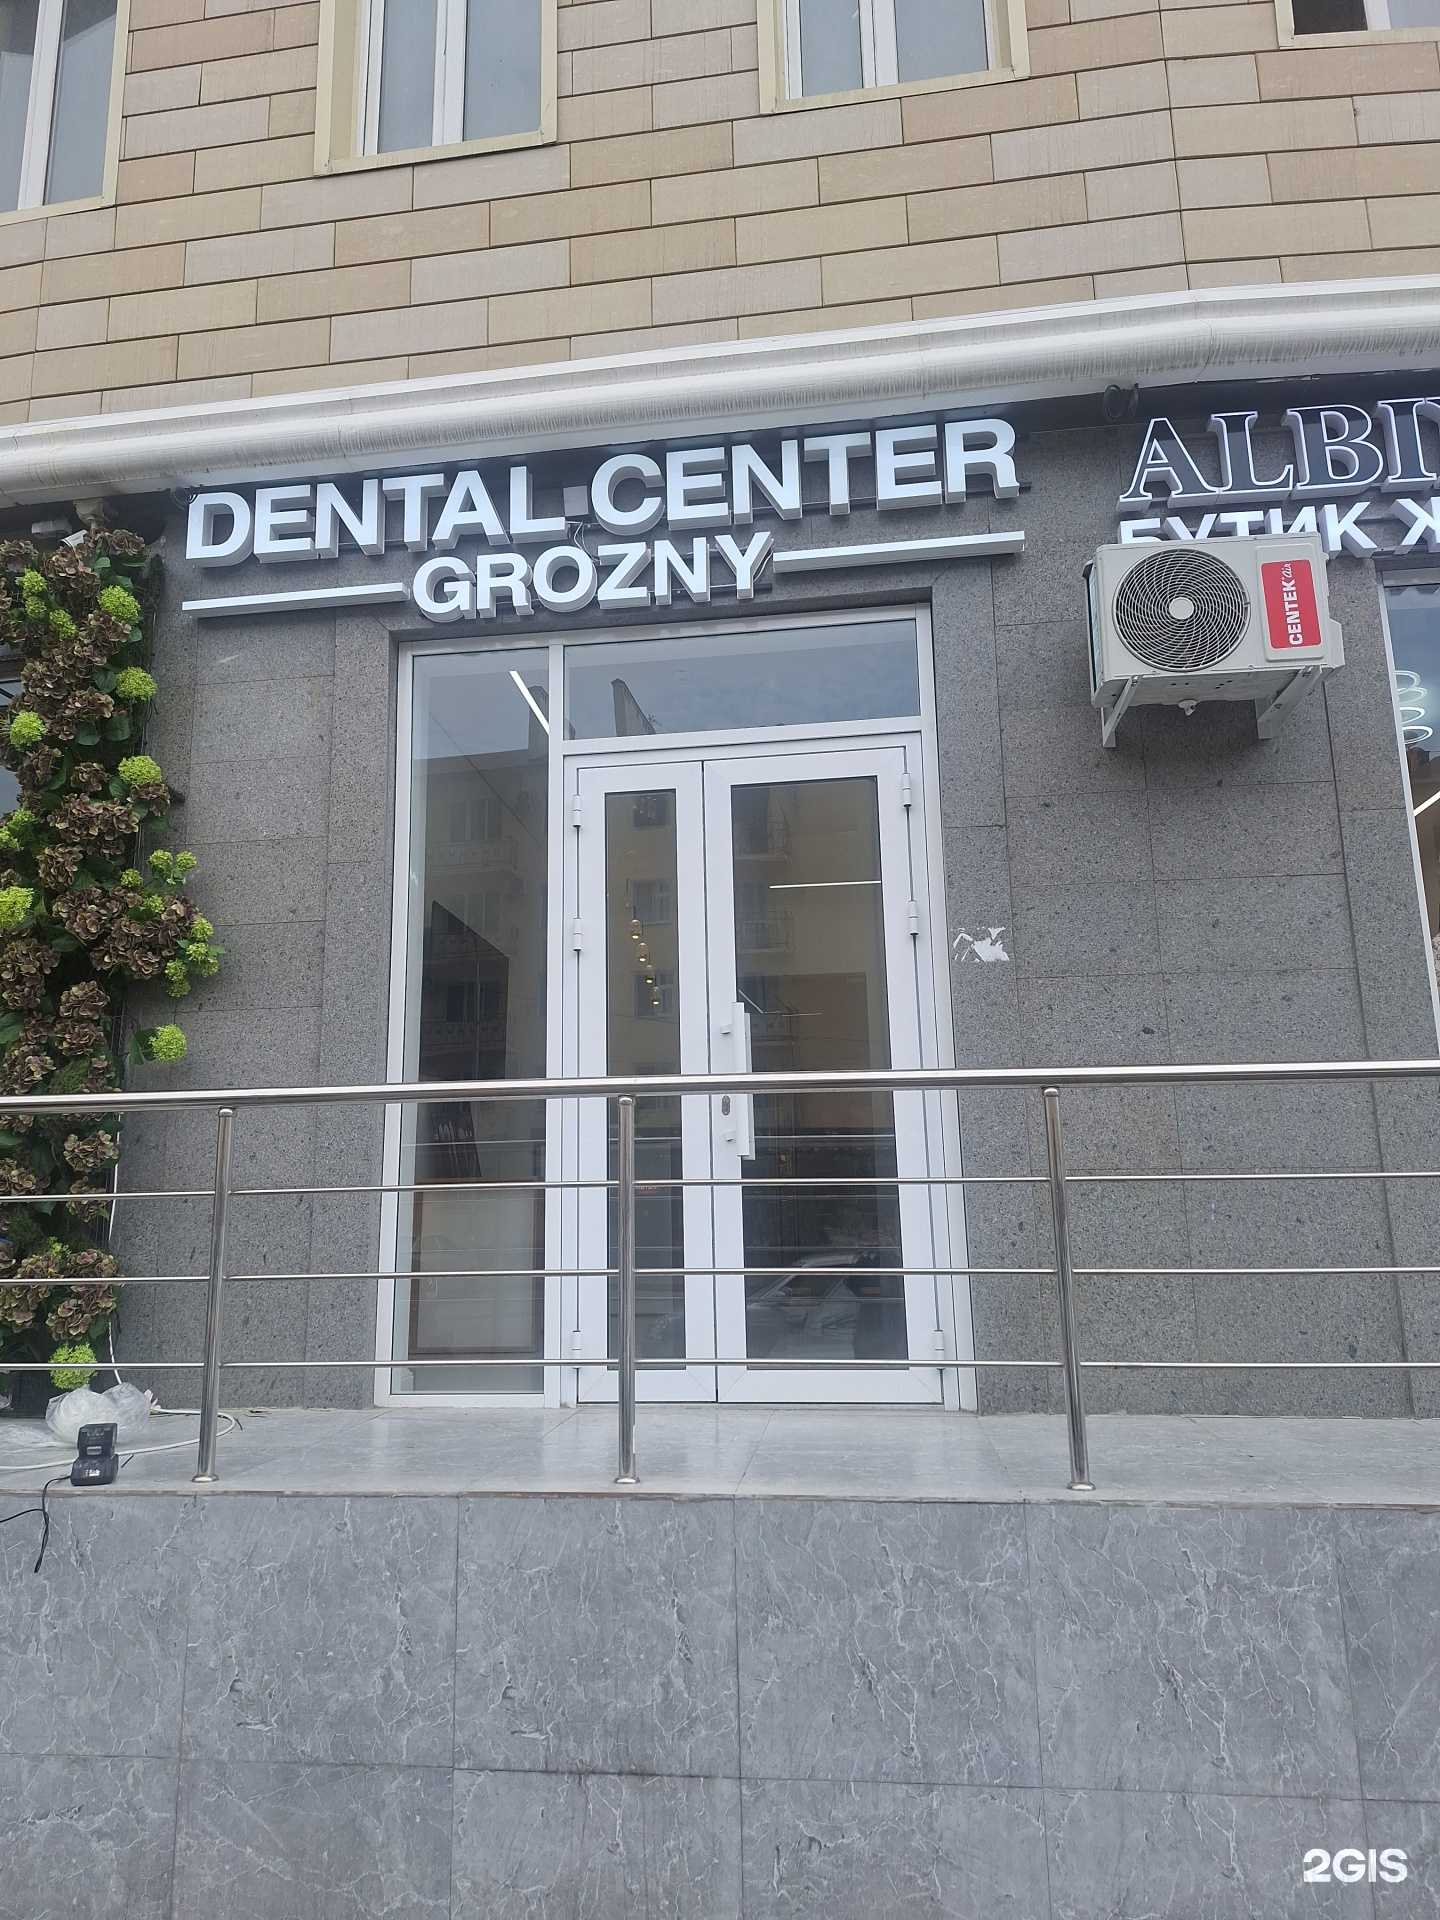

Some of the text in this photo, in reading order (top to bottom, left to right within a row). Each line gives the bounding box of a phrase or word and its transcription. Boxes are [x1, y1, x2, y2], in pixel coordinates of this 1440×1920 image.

[185, 418, 1019, 567] DENTAL CENTER
[1119, 397, 1440, 501] ALBI
[409, 530, 775, 620] GROZNY
[1281, 579, 1303, 645] CENTEK
